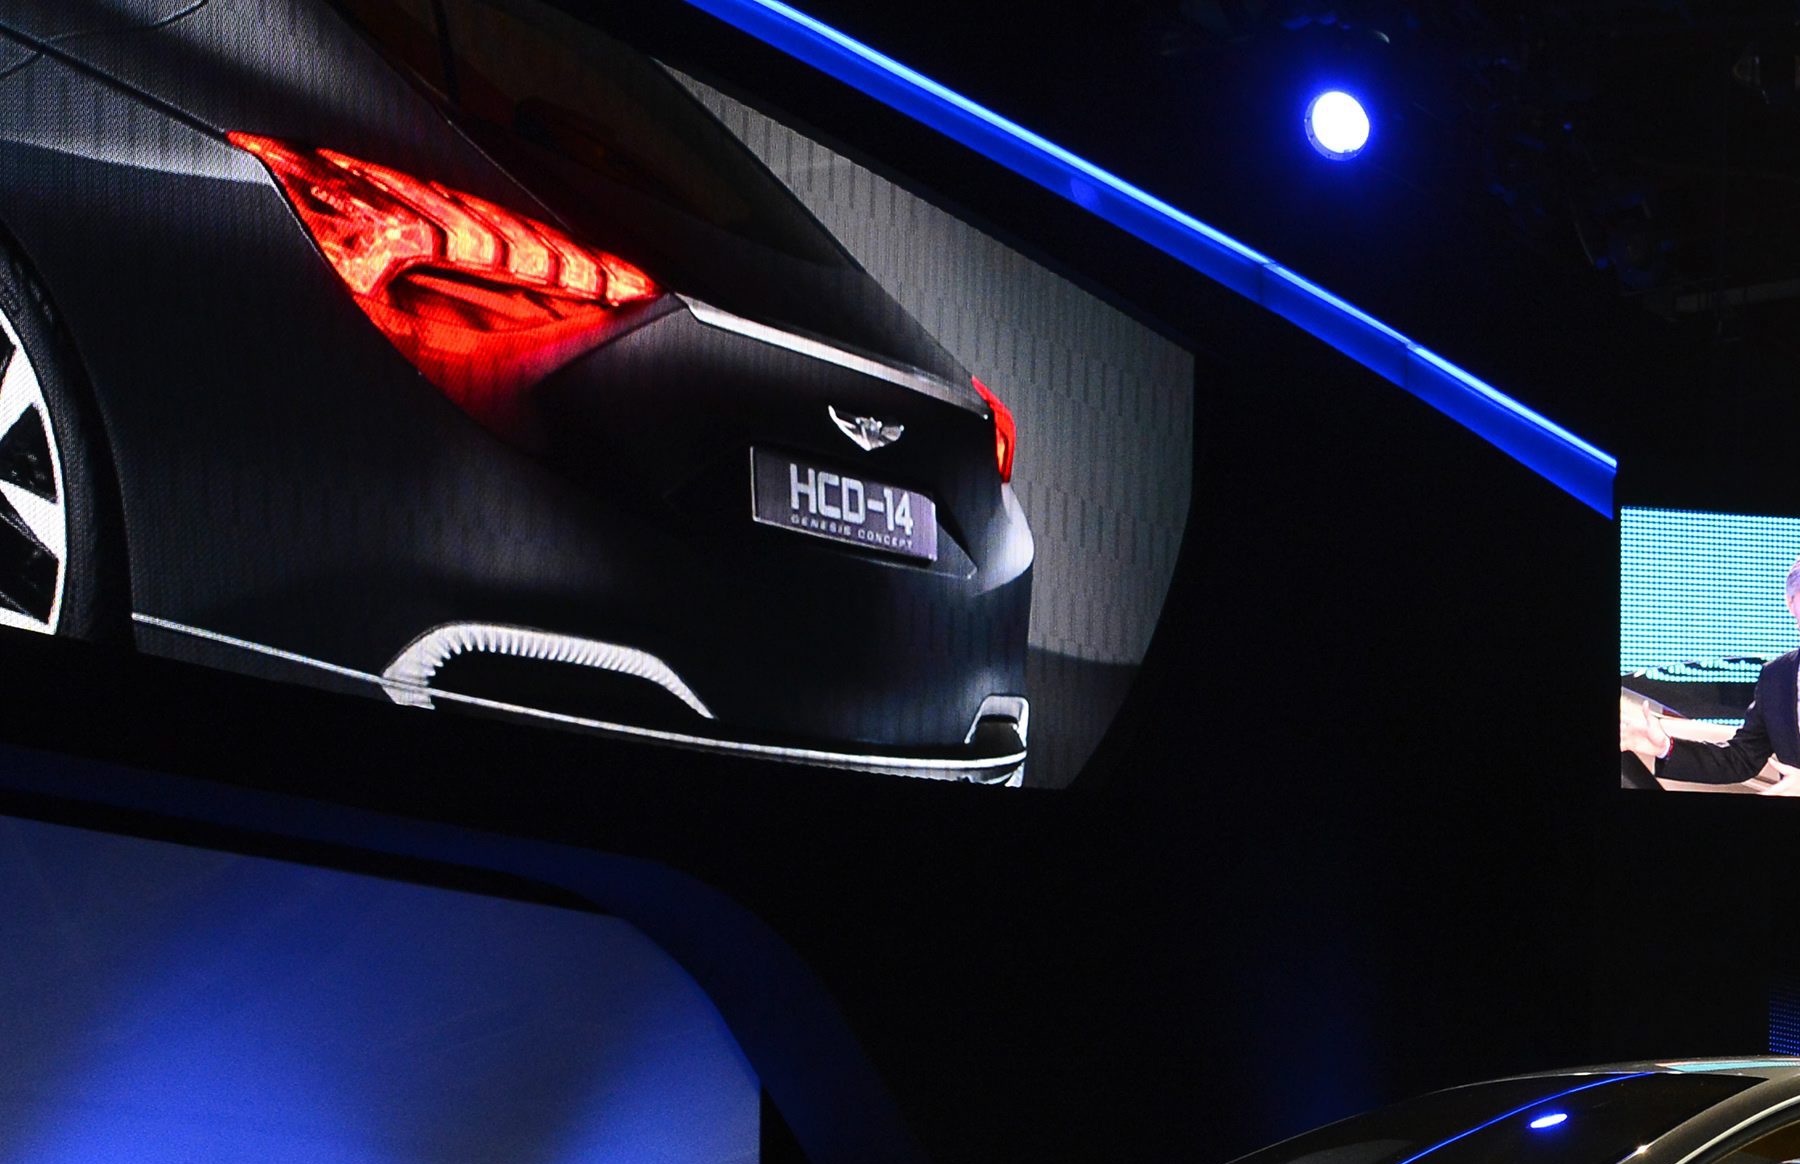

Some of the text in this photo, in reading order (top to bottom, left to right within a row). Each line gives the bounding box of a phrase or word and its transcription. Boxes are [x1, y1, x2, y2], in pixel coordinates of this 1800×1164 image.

[789, 463, 914, 535] HCD-14
[791, 514, 914, 549] GENESIS CONCEPT
